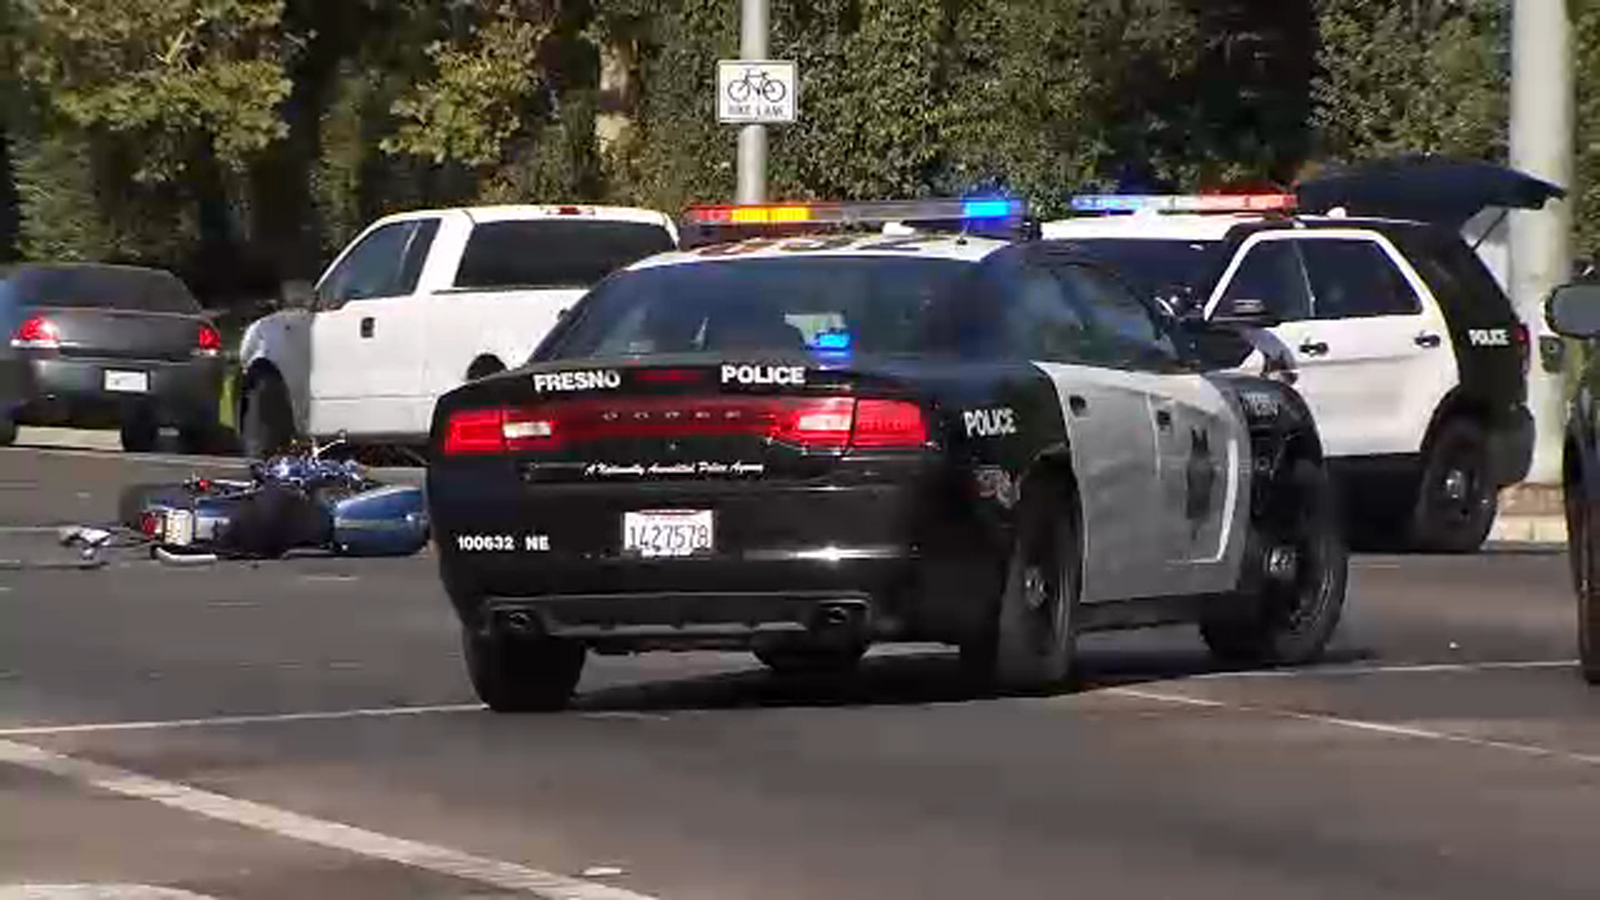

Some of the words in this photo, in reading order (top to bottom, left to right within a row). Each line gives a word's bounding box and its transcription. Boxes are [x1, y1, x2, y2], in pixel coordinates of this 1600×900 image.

[1468, 329, 1511, 346] POLICE
[534, 370, 621, 392] FRESNO
[720, 364, 806, 384] POLICE
[963, 406, 1017, 437] POLICE
[458, 534, 515, 551] 100632
[525, 534, 551, 551] NE
